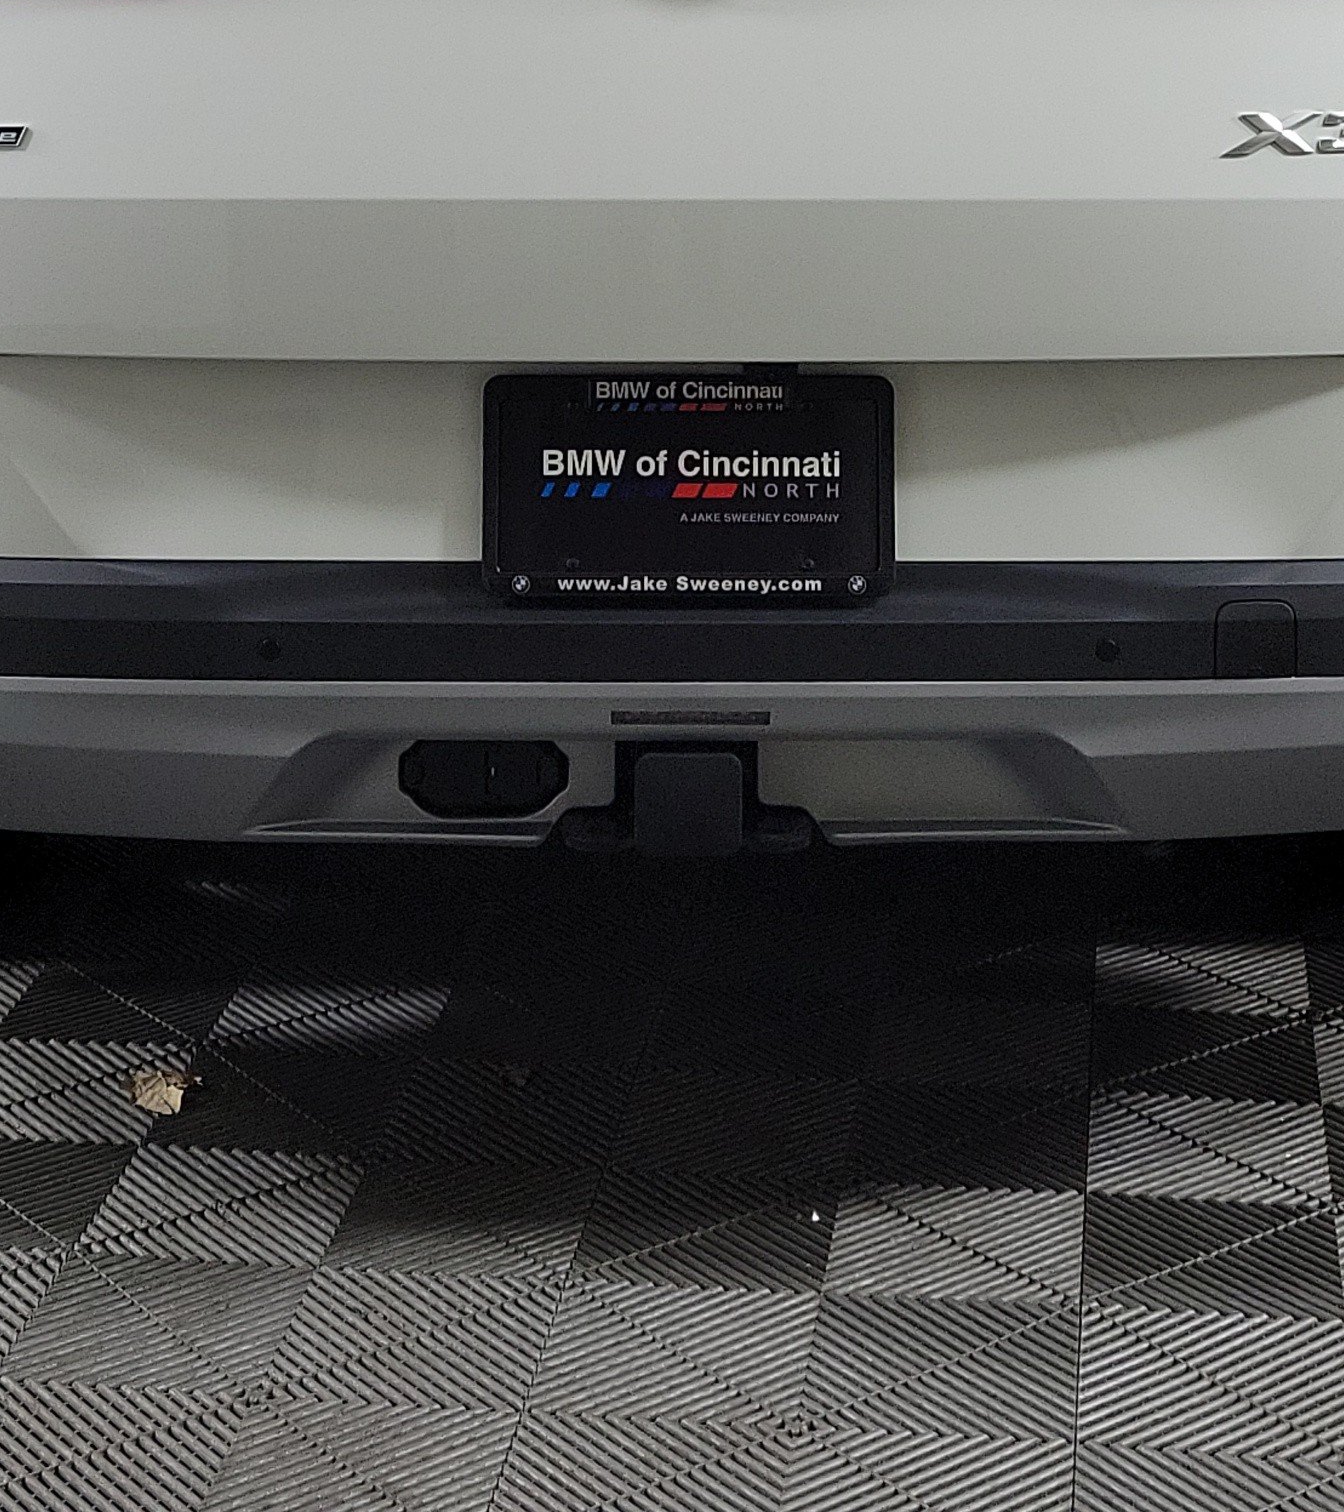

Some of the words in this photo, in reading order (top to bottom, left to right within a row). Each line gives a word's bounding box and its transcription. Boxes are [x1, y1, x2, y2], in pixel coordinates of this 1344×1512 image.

[595, 381, 651, 400] BMW
[656, 381, 677, 400] of
[682, 381, 784, 400] Cincinnati
[733, 403, 784, 411] NORTH
[542, 449, 626, 476] BMW
[636, 449, 668, 477] of
[677, 449, 841, 477] Cincinnati
[742, 483, 840, 498] NORTH
[679, 513, 689, 522] A
[690, 513, 722, 522] JAKE
[723, 513, 780, 523] SWEENEY
[782, 513, 840, 523] COMPANY
[676, 575, 822, 594] Sweeney.com
